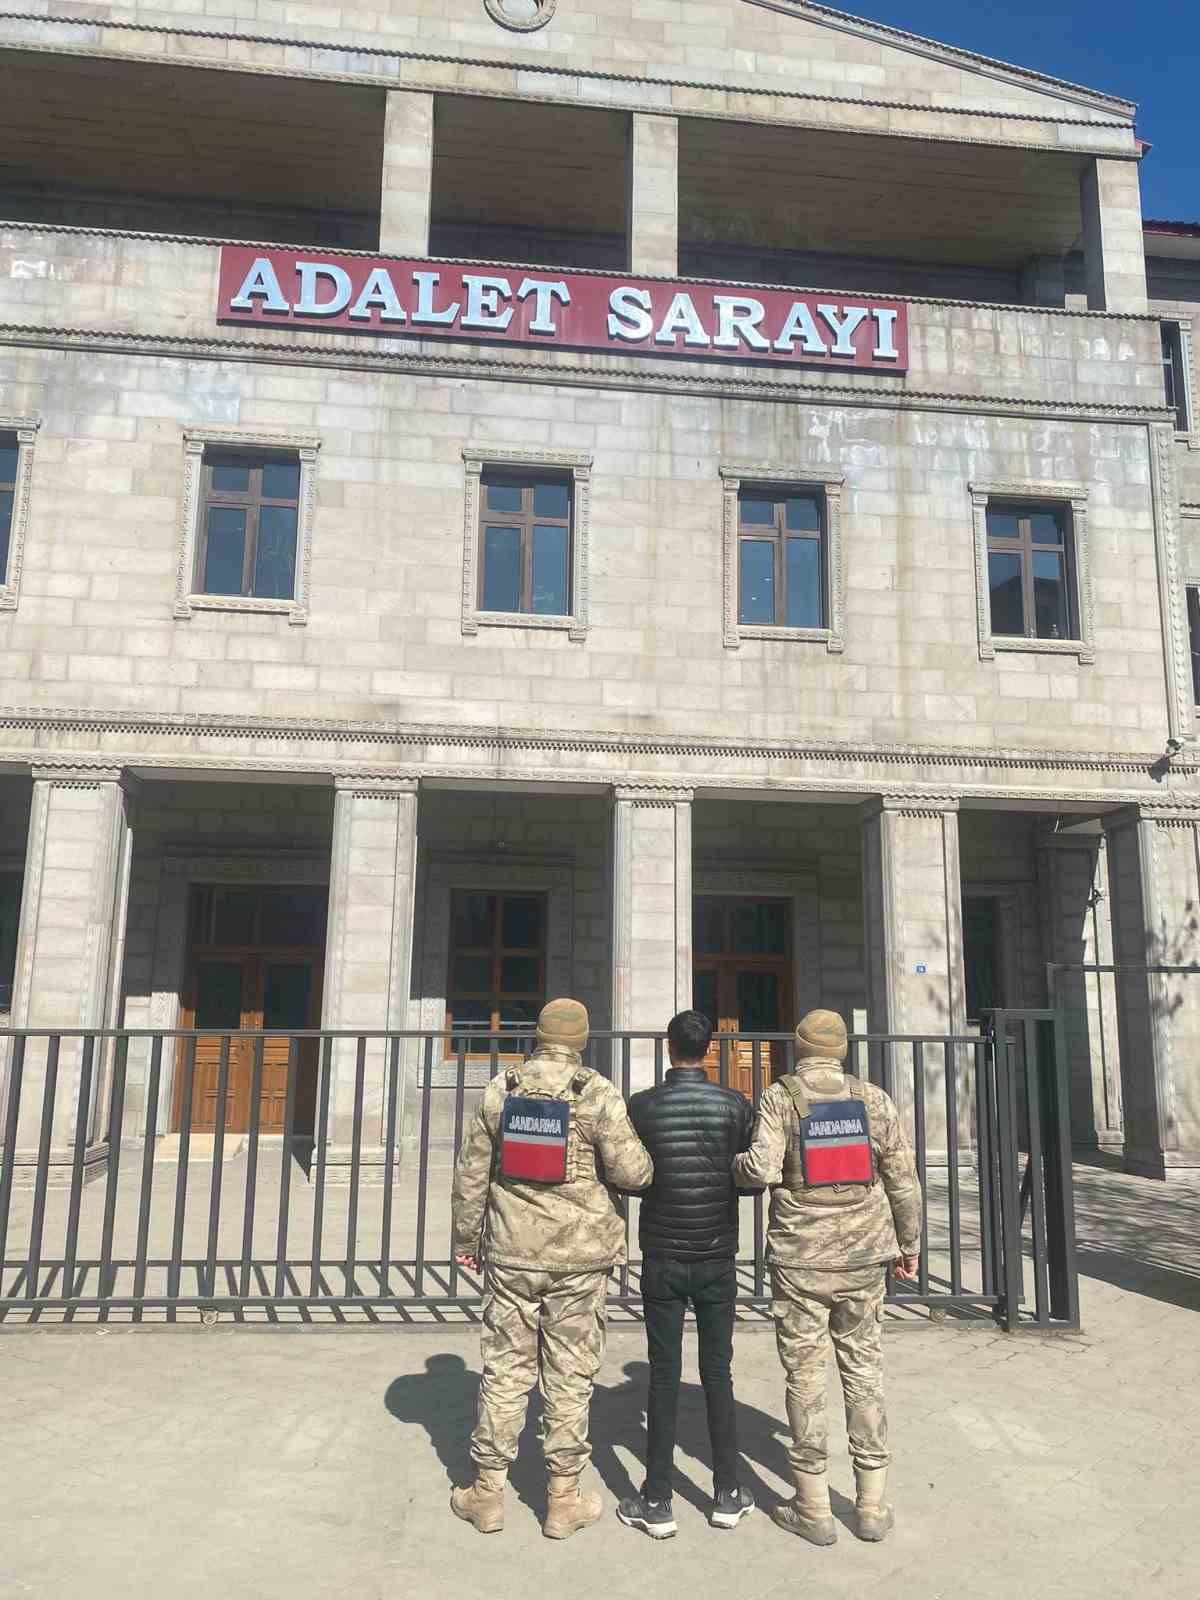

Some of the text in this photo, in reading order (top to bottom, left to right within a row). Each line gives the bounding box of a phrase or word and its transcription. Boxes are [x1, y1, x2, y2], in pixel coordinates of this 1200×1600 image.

[230, 257, 898, 361] ADALET SARAYI
[508, 1115, 562, 1134] JANDARMA
[808, 1119, 864, 1136] JANDARMA
